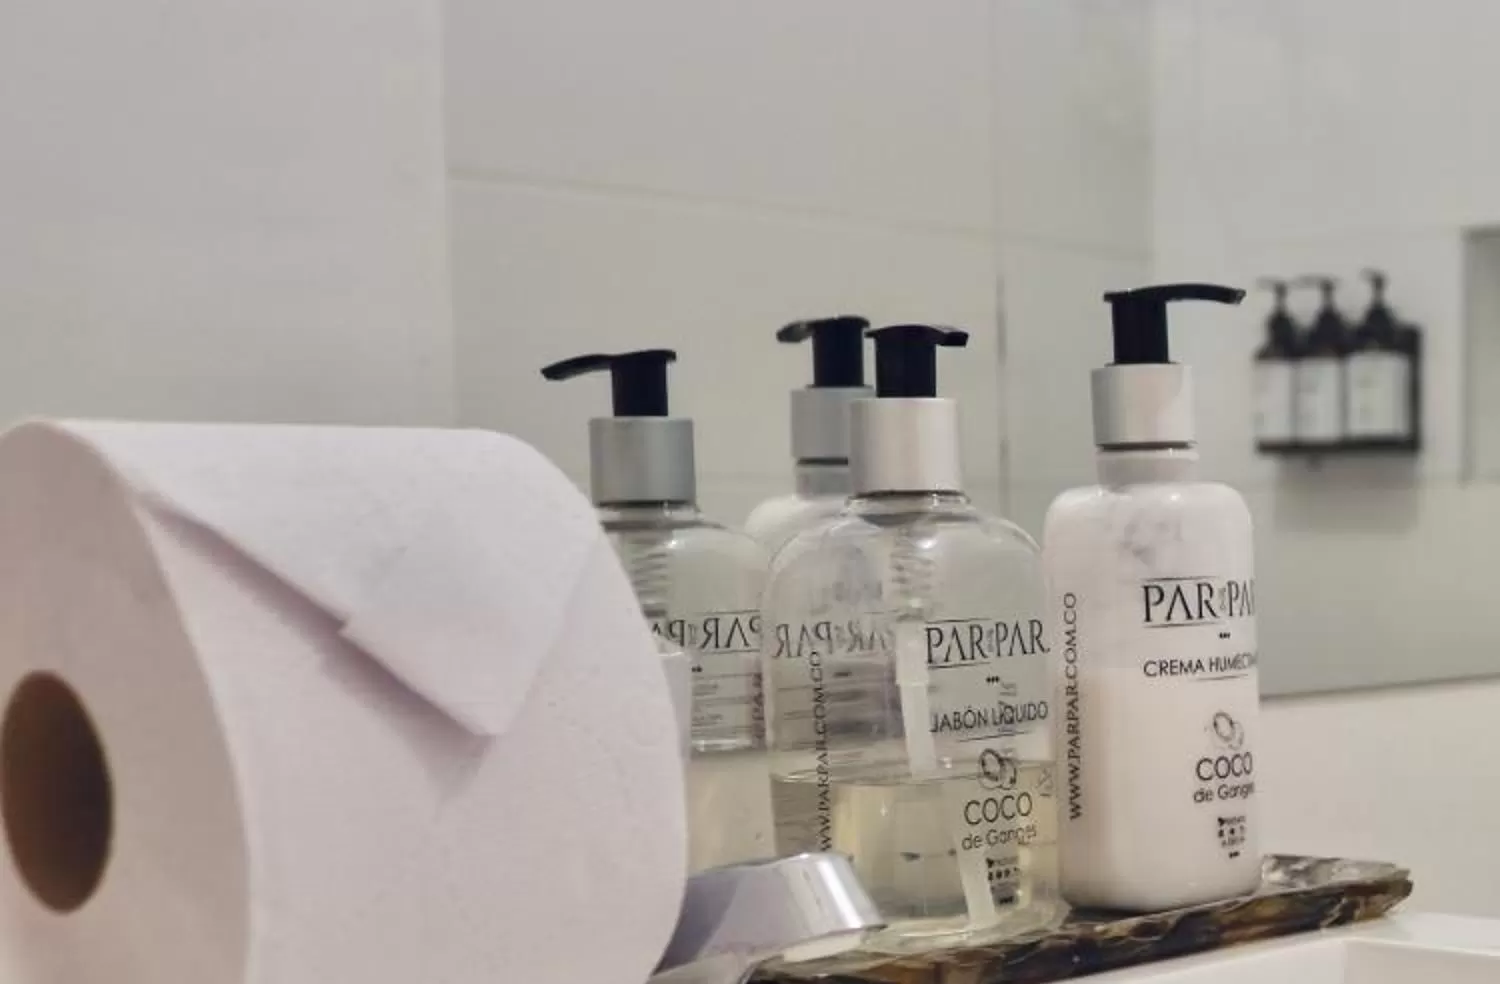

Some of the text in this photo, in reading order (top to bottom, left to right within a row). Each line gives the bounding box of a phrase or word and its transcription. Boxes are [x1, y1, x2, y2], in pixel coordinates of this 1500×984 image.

[1142, 583, 1218, 622] PAR
[925, 619, 1051, 664] PAR PAR
[1143, 659, 1205, 677] CREMA
[1063, 592, 1082, 821] WWW.PARPAR.COM.CO
[809, 651, 832, 852] WW.PARPAR.COM.CO
[1196, 752, 1253, 780] COCO
[964, 792, 1032, 825] COCO
[1193, 787, 1213, 803] de
[961, 833, 982, 850] de
